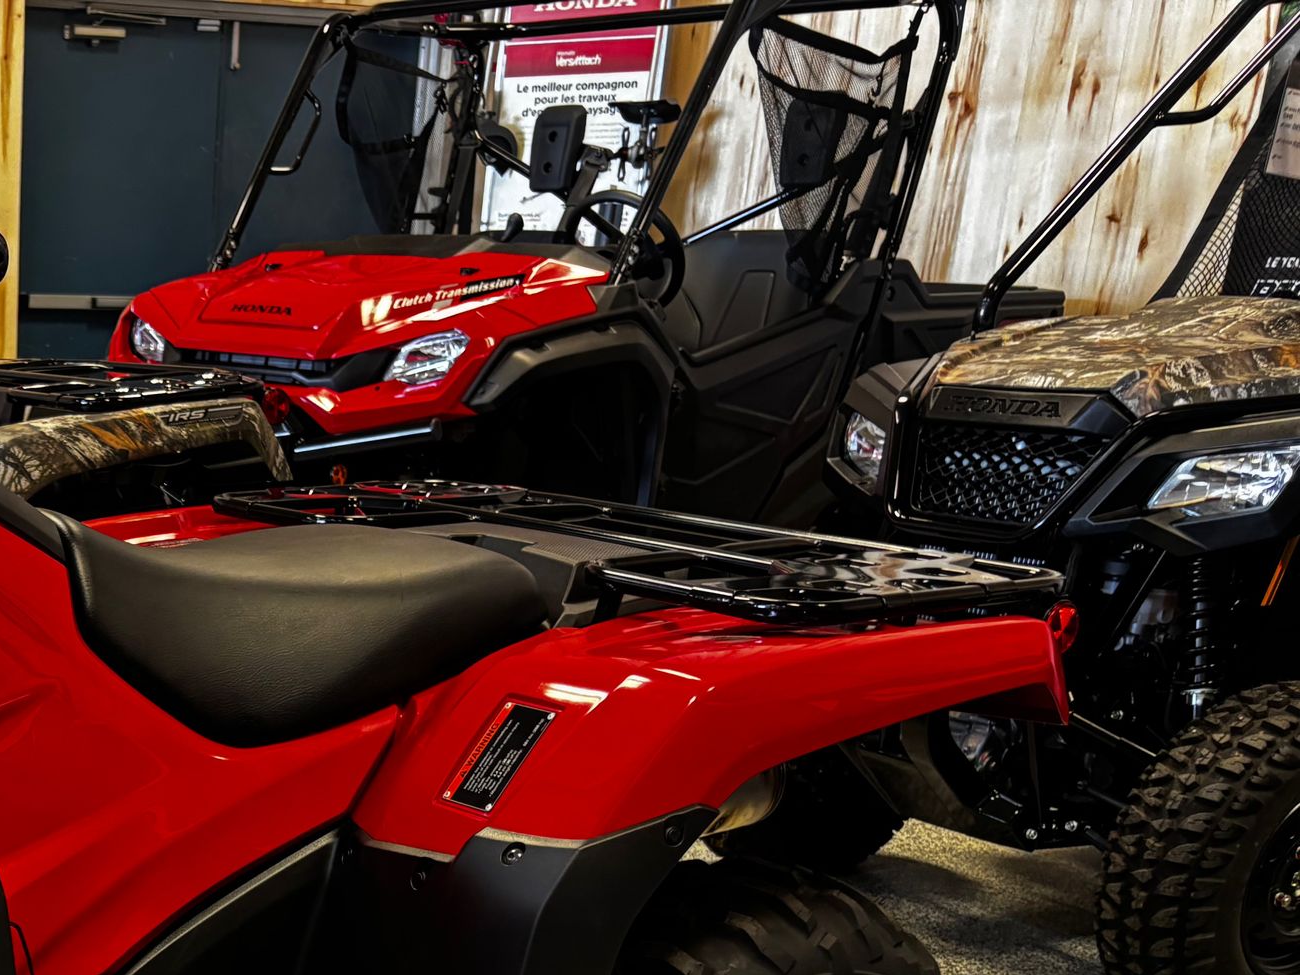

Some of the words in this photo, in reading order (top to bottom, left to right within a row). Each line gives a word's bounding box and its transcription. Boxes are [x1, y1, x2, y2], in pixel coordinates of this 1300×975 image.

[517, 84, 529, 93] Le
[532, 82, 573, 92] meilleur
[576, 80, 638, 92] compagnon
[534, 95, 557, 105] pour
[561, 94, 575, 103] les
[579, 93, 617, 103] travaux
[393, 292, 434, 309] Clutch
[436, 277, 515, 301] Transmission
[230, 303, 293, 316] HONDA
[943, 394, 1061, 417] HONDA
[168, 409, 206, 422] IRS
[467, 722, 500, 766] WARNING
